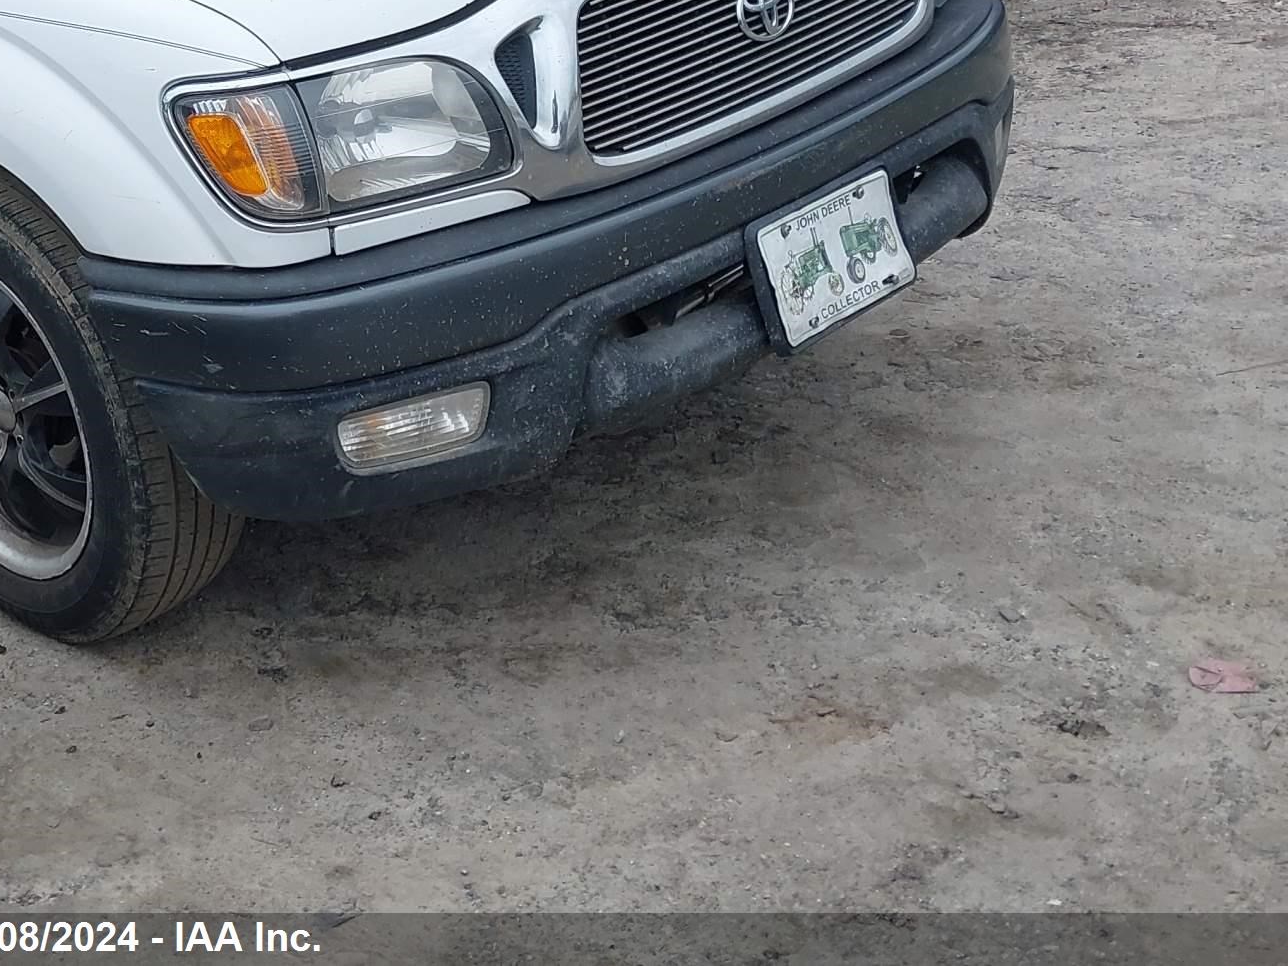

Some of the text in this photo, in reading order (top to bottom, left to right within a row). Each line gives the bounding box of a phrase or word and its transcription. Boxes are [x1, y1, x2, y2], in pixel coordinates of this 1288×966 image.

[795, 194, 852, 232] JOHN DEERE
[821, 279, 881, 320] COLLECTOR
